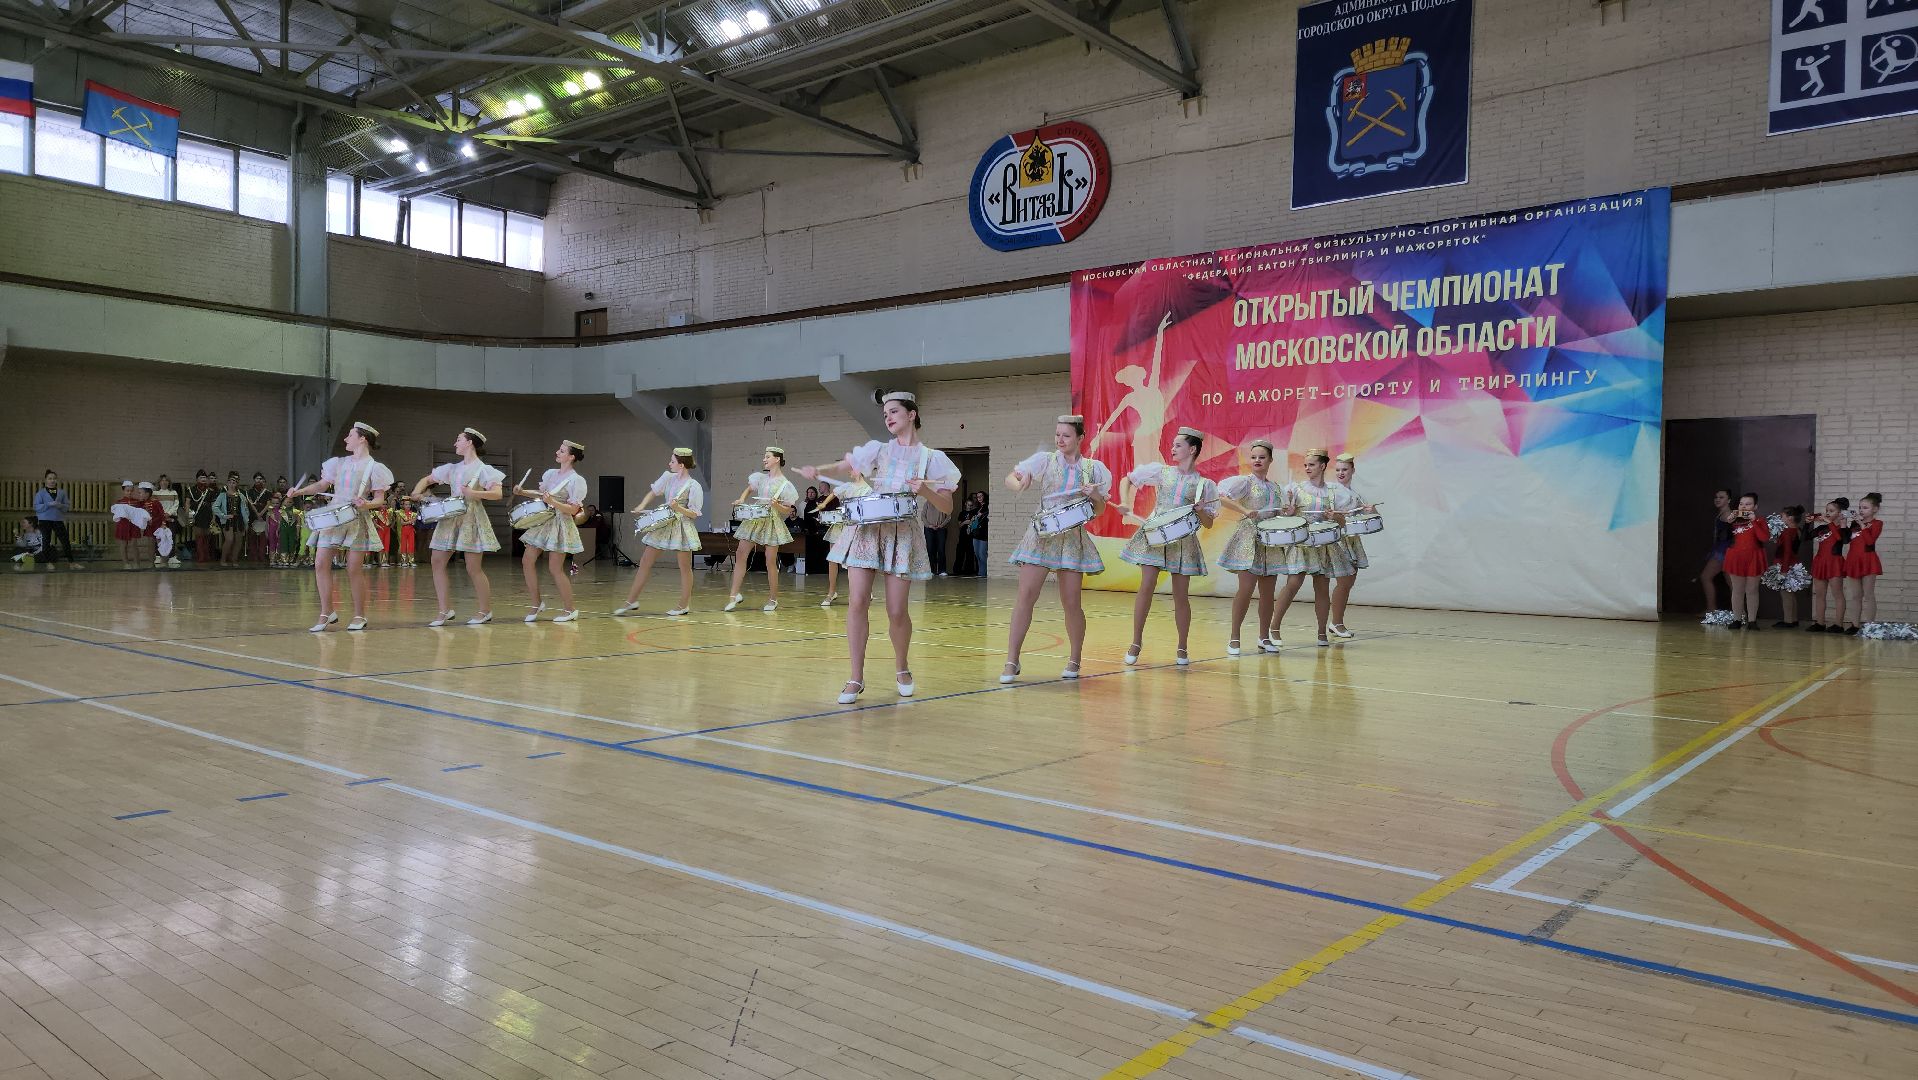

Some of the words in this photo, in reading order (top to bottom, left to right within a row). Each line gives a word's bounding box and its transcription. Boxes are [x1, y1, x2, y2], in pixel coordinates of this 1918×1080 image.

[1298, 14, 1364, 40] ГОРОДСКОГО
[1366, 4, 1408, 23] ОКРУГА
[1082, 266, 1147, 282] МОСКОВСКАЯ
[1151, 257, 1213, 272] ОБЛАСТНАЯ
[1218, 244, 1309, 264] РЕГИОНАЛЬНАЯ
[1314, 214, 1517, 250] ФИЗКУЛЬТУРНО-СПОРТИВНАЯ
[1524, 197, 1643, 221] ОРГАНИЗАЦИЯ
[1258, 259, 1295, 271] БАТОН
[1301, 249, 1374, 266] ТВИРЛИНГА
[1380, 247, 1389, 256] И
[1233, 280, 1374, 328] ОТКРЫТЫЙ
[1382, 263, 1565, 312] ЧЕМПИОНАТ
[1235, 324, 1408, 370] МОСКОВСКОЙ
[1417, 315, 1556, 357] ОБЛАСТИ
[1202, 392, 1223, 406] ПО
[1236, 380, 1413, 404] МАЖОРЕТ-СПОРТУ
[1429, 379, 1441, 393] И
[1458, 369, 1599, 391] ТВИРЛИНГУ
